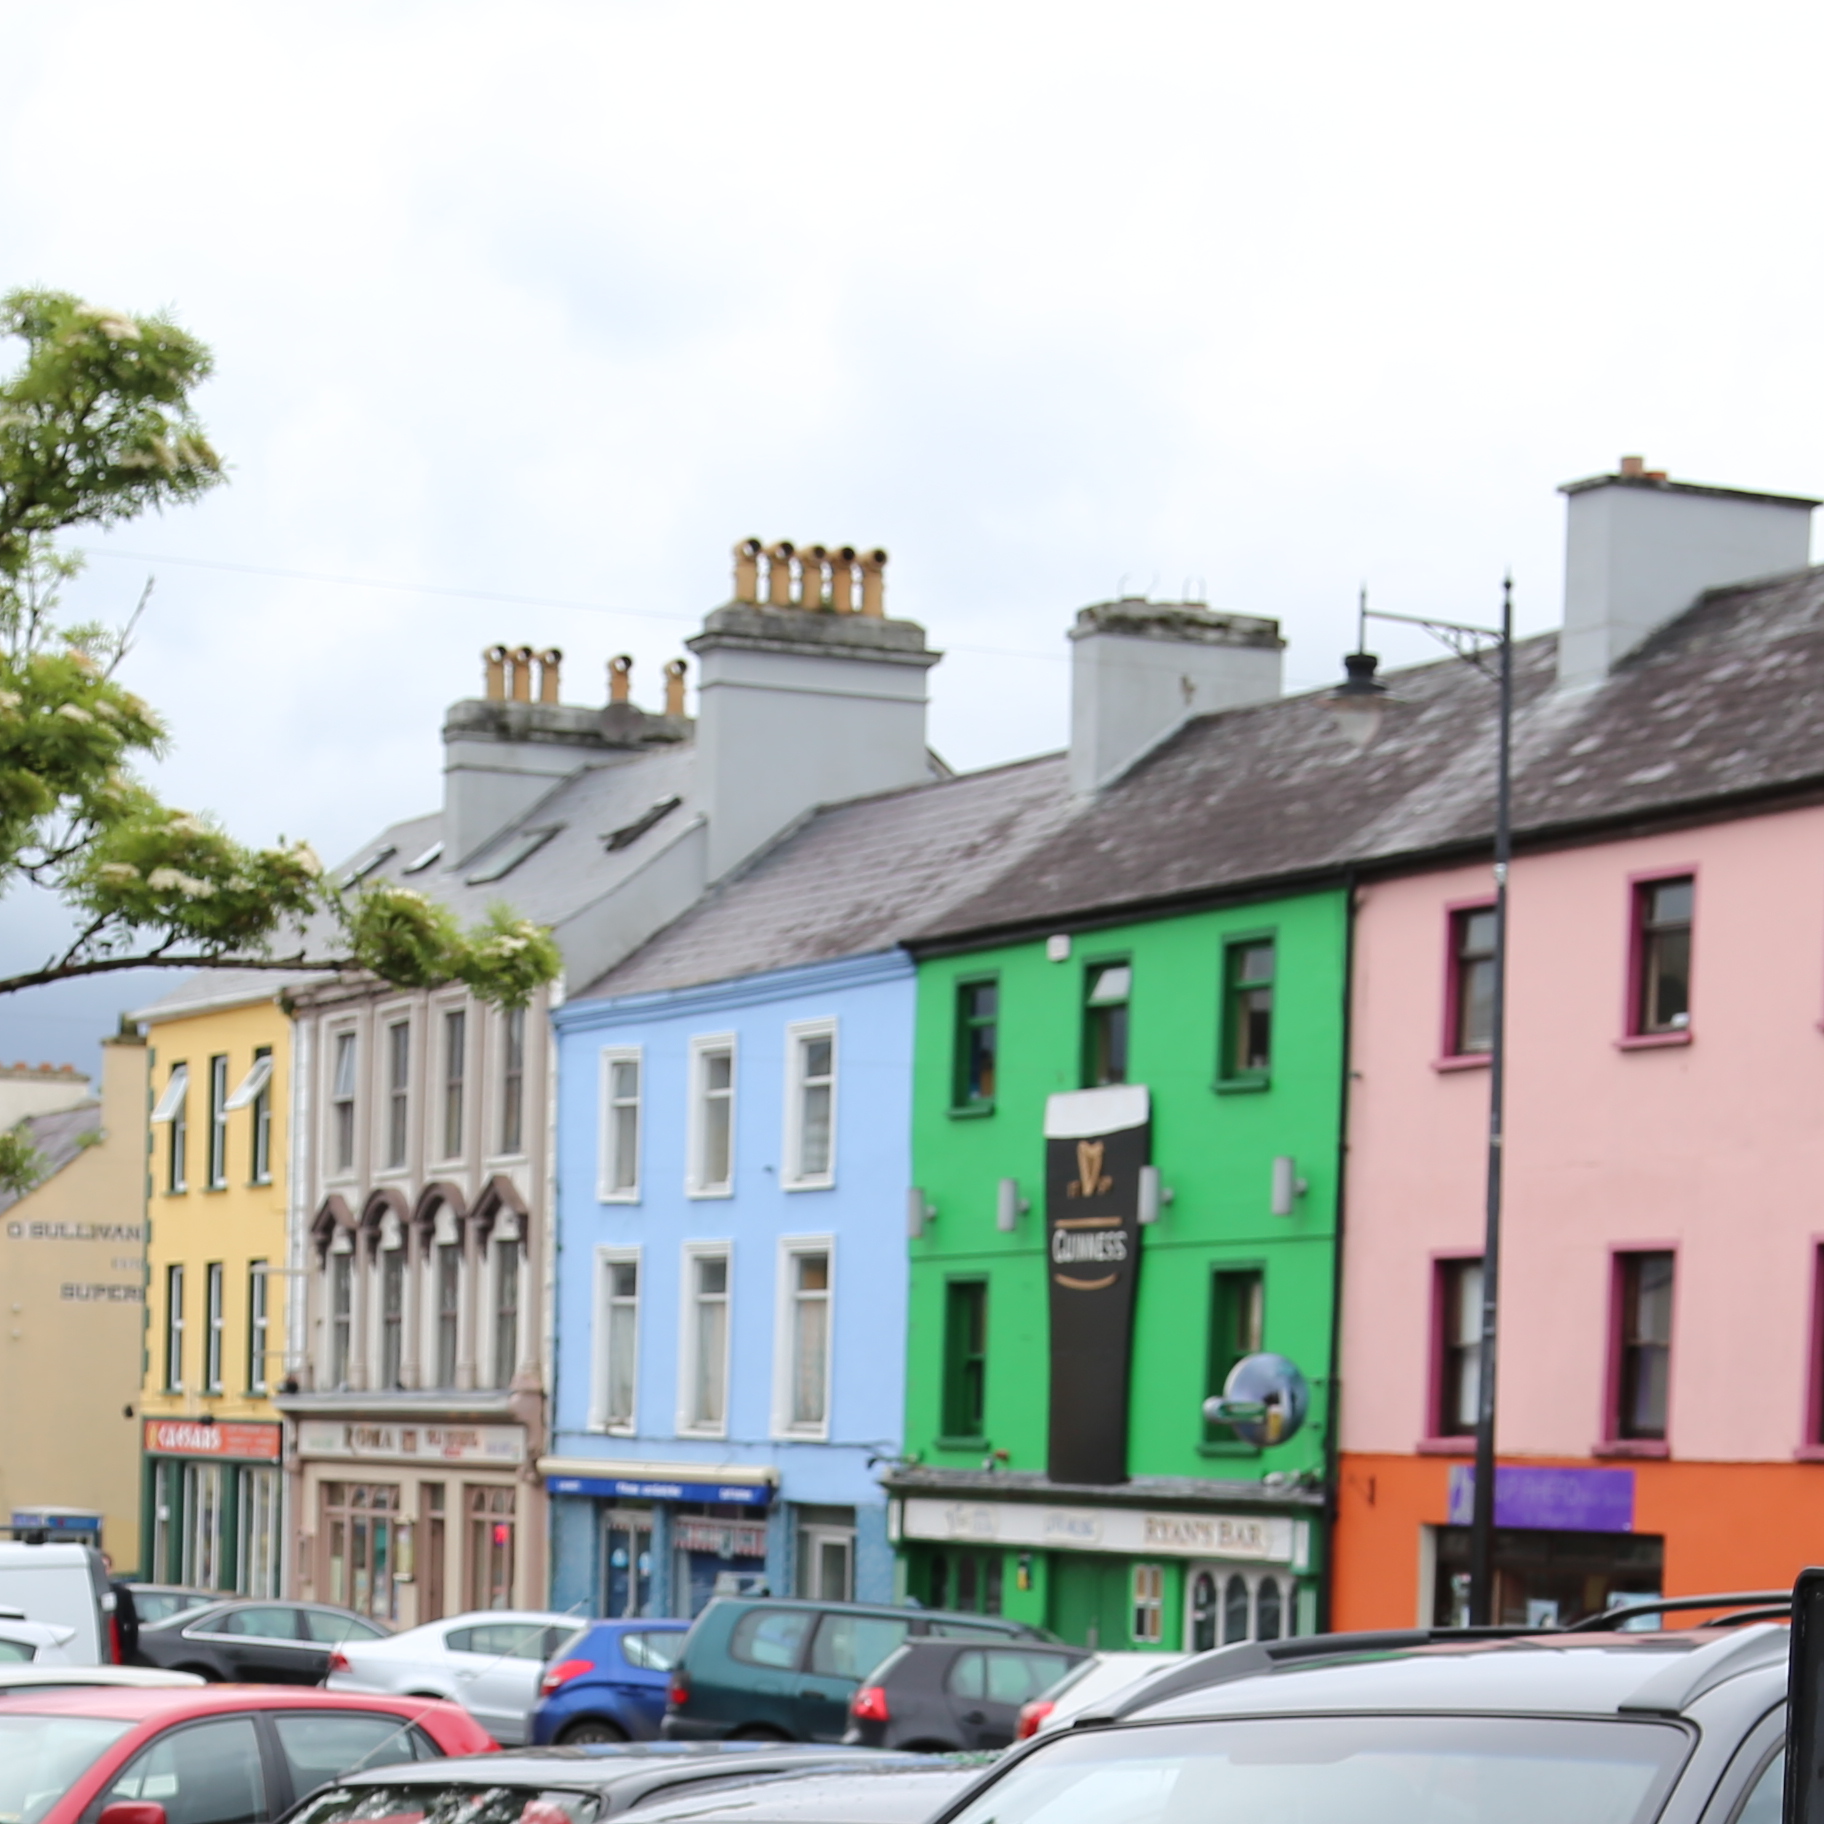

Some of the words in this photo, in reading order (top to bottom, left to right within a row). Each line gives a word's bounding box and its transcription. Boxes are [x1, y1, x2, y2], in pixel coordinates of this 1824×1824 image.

[30, 1222, 141, 1241] SULLIVAN
[1052, 1228, 1128, 1263] GUINNESS
[1219, 1518, 1266, 1551] BAR
